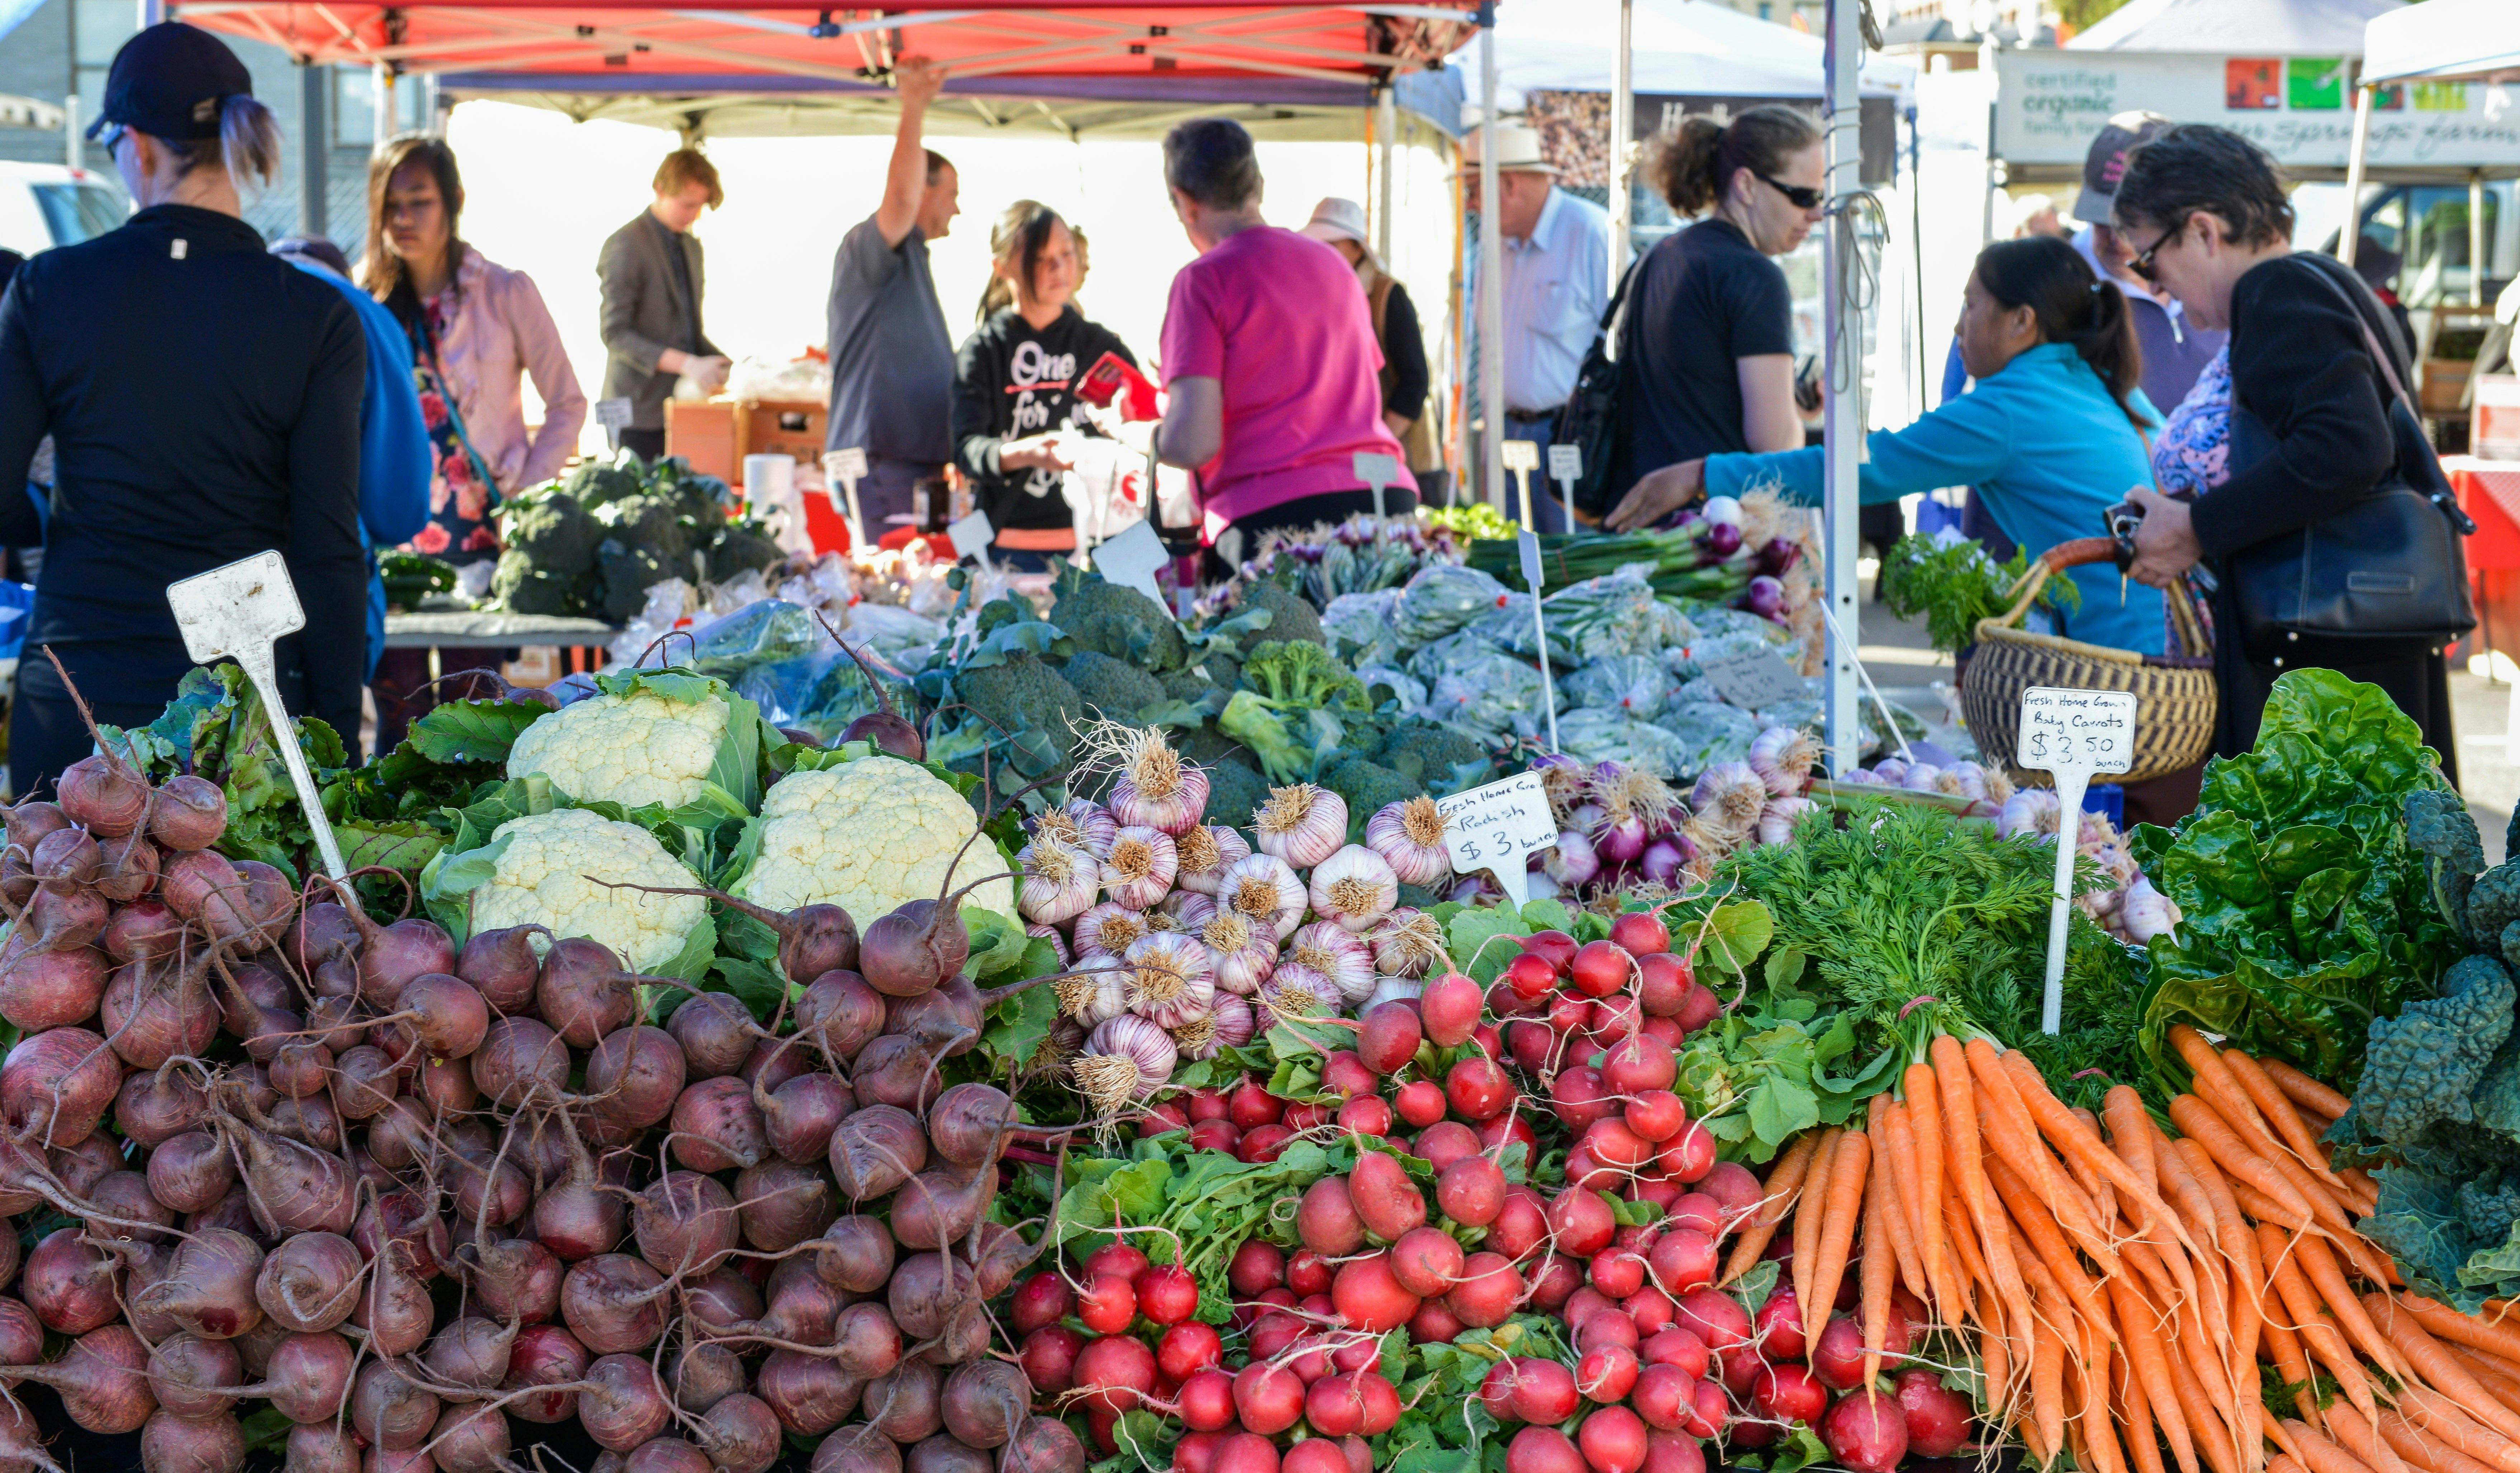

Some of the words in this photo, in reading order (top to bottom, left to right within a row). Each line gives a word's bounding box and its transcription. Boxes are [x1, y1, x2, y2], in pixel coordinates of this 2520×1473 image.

[2023, 91, 2115, 121] organic
[1010, 340, 1076, 386] One
[1001, 390, 1049, 442] for
[2025, 691, 2052, 706] Fresh
[2059, 695, 2088, 708] Home
[2034, 711, 2064, 735] Baby
[2072, 713, 2123, 728] Carrots
[2095, 758, 2125, 768] bunch
[1439, 799, 1476, 815] Fresh
[1480, 787, 1511, 802] Home
[1460, 804, 1525, 832] Radish
